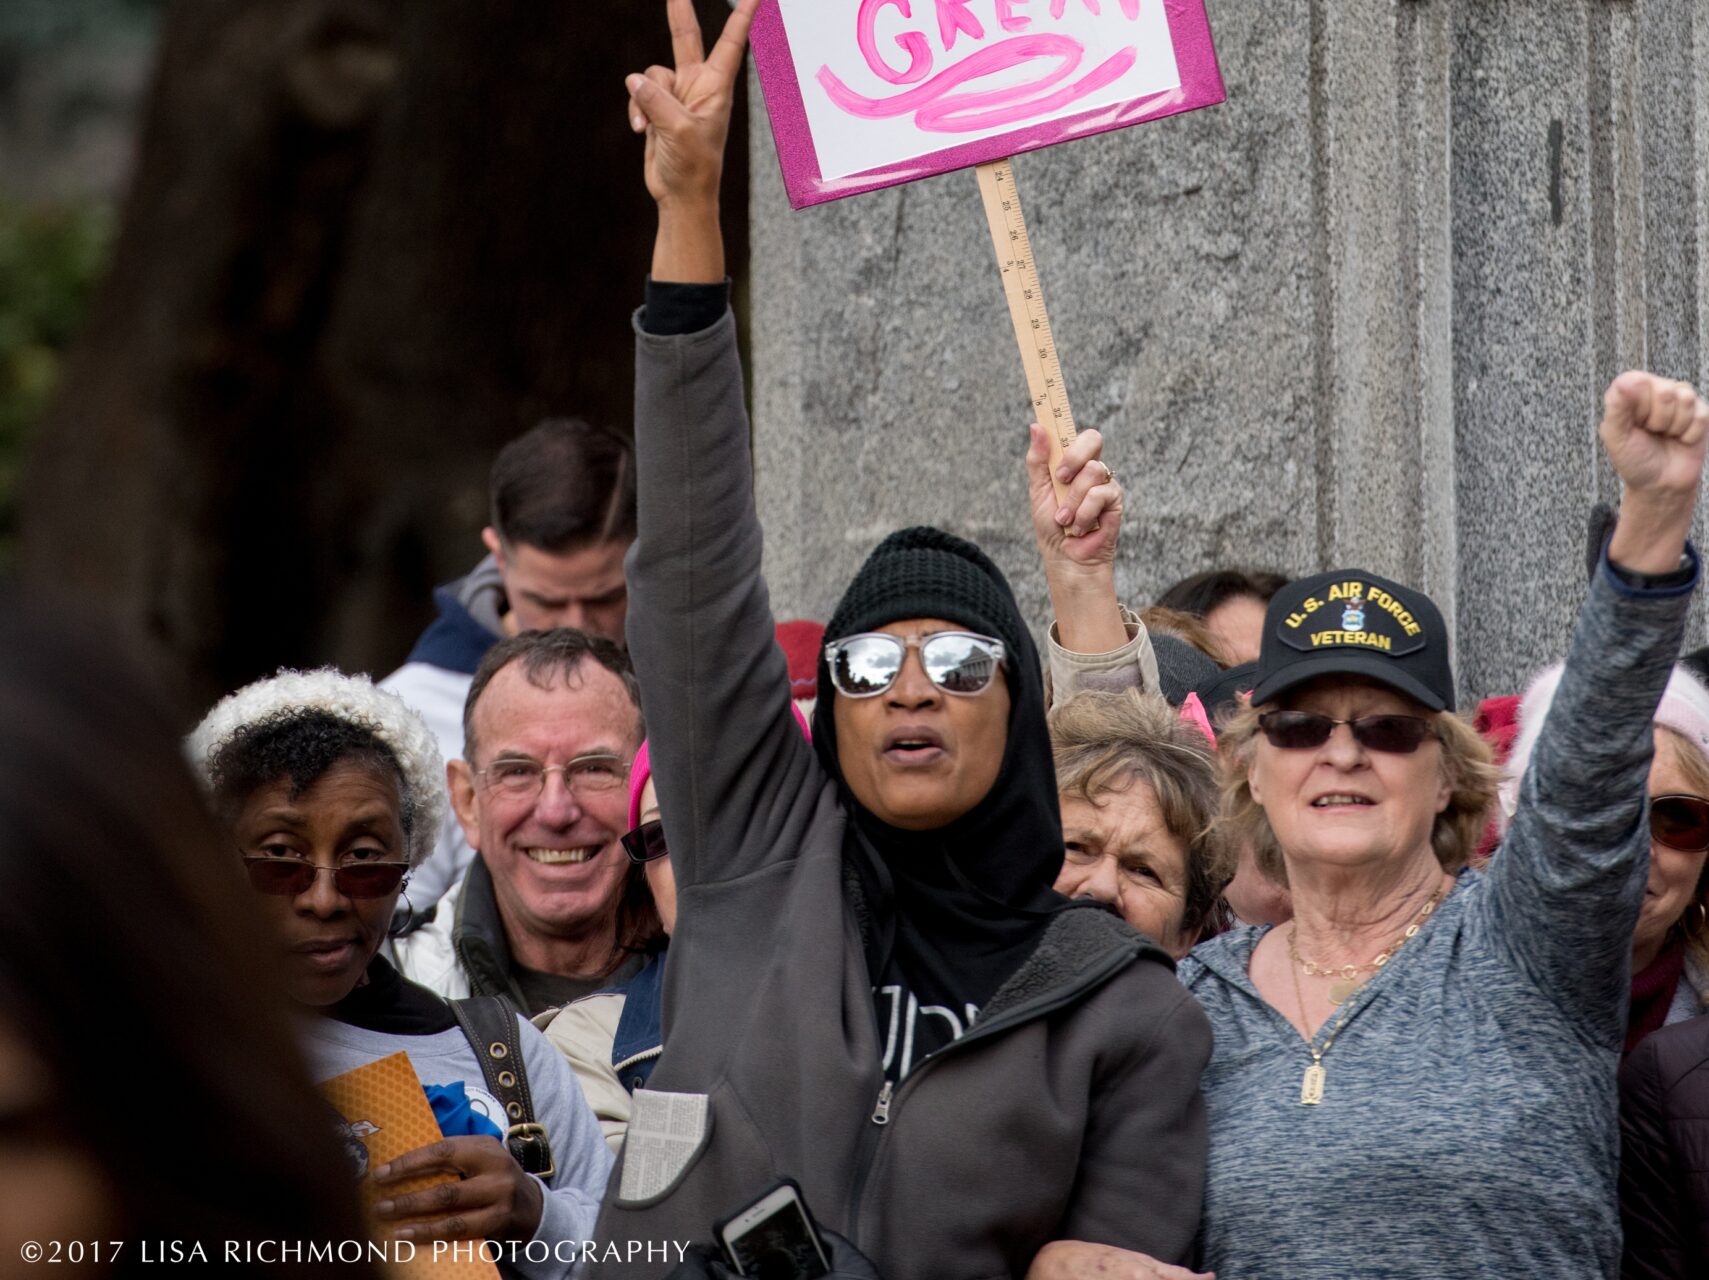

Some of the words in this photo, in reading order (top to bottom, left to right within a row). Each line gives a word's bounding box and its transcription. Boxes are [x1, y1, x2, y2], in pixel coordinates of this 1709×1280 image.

[1285, 597, 1325, 629] U.S.
[1328, 581, 1363, 602] AIR
[1366, 586, 1421, 636] FORCE
[1310, 630, 1392, 650] VETERAN
